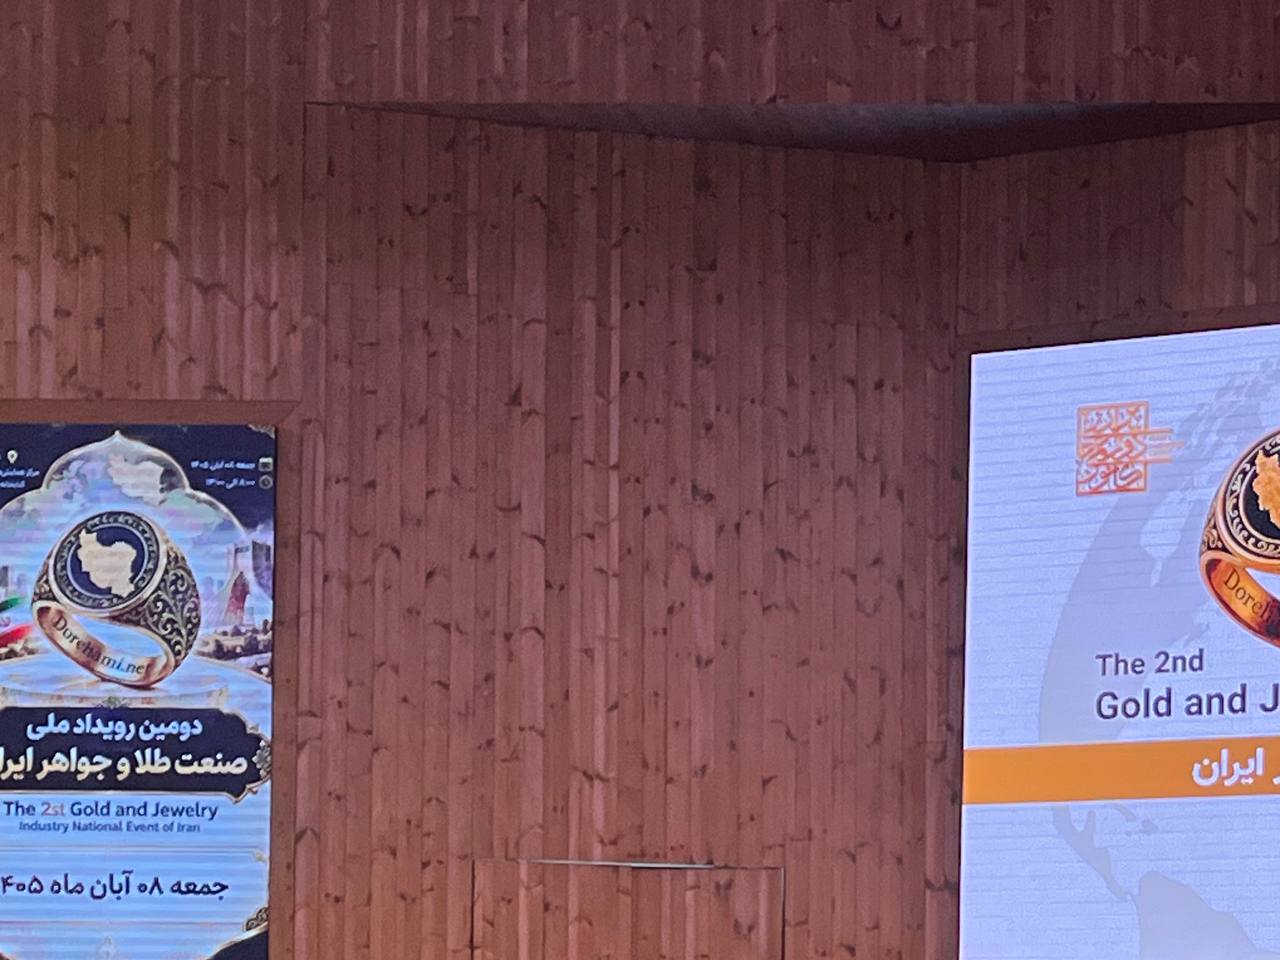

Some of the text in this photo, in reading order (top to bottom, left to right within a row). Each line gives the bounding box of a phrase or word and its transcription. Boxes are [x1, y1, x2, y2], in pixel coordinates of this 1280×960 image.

[1096, 648, 1204, 676] The 2nd
[1096, 686, 1172, 720] Gold
[1184, 683, 1247, 717] and
[26, 712, 202, 742] دومین رویداد ملی
[0, 745, 248, 781] صنعت طلا و جواهر ایرا
[1191, 747, 1264, 786] ایران
[3, 801, 219, 821] The 2st Gold and Jewelry
[19, 820, 201, 834] Industry National Event of Iran
[0, 869, 229, 902] جمعه ۰۸ آبان ماه ۴۰۵
